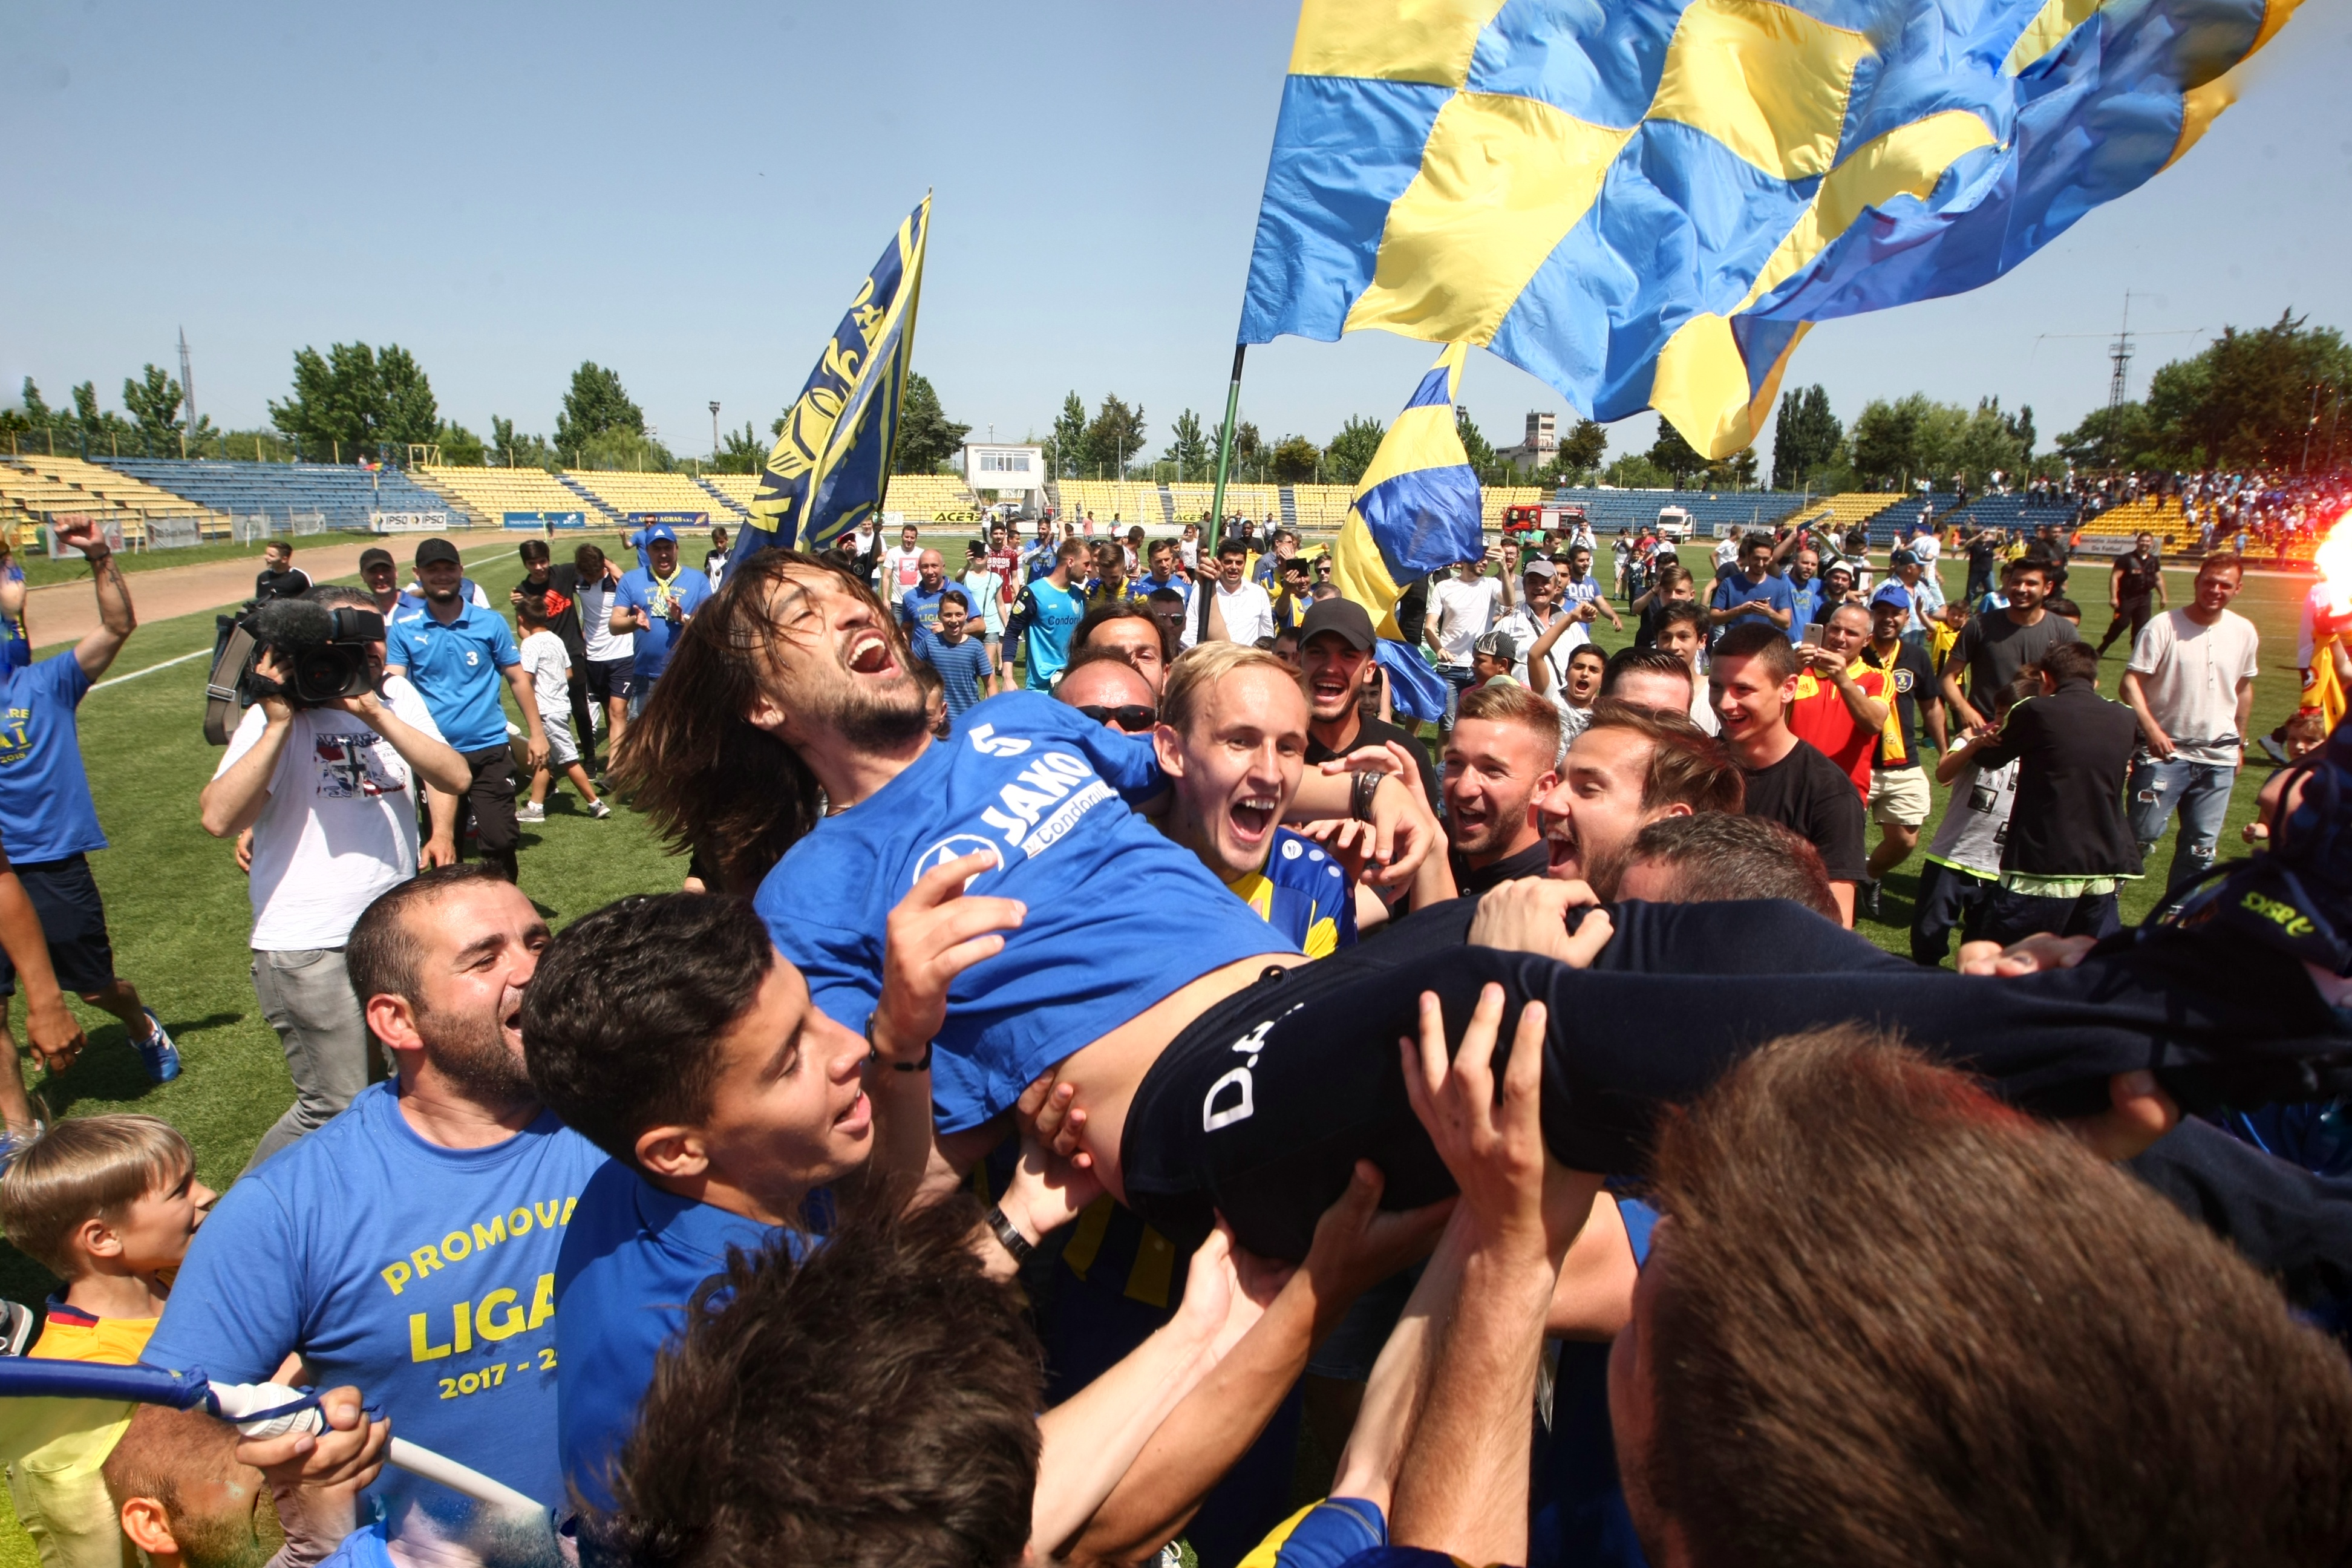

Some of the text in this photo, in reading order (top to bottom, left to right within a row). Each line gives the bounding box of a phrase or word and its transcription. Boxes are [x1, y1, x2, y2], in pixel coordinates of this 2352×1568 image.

[386, 516, 407, 524] IPSO
[422, 515, 445, 524] IPSO
[1048, 615, 1079, 626] Condor
[466, 652, 479, 666] 3
[622, 682, 631, 694] 7
[968, 723, 1031, 757] 5
[420, 789, 428, 804] 3
[981, 751, 1092, 847] JAKO
[381, 1196, 578, 1296] PROMOVA
[409, 1272, 555, 1363] LIGA
[439, 1362, 508, 1399] 2017
